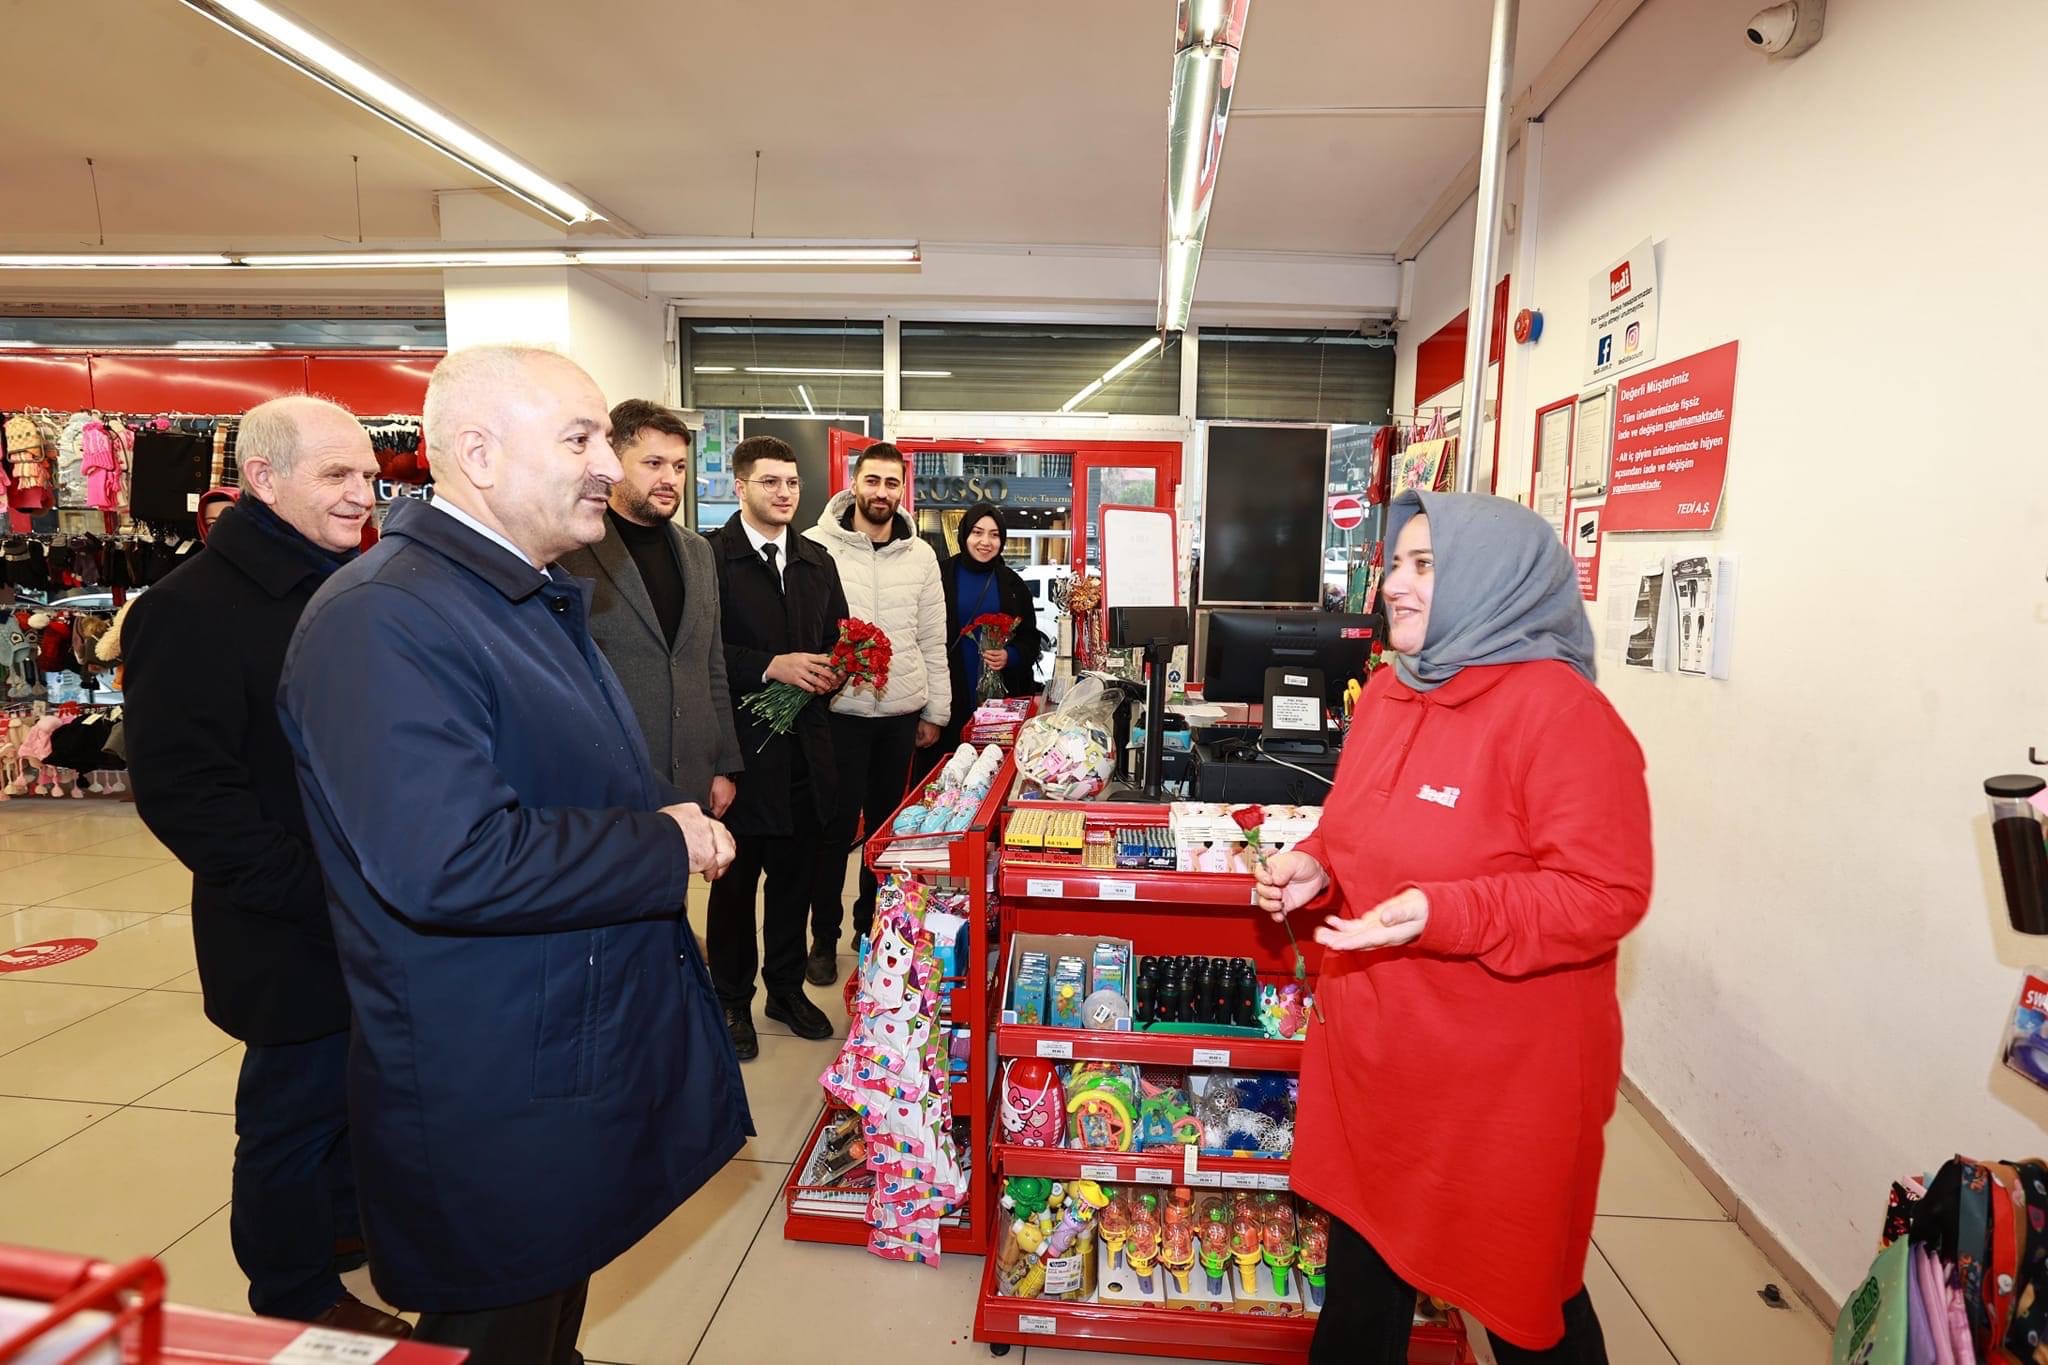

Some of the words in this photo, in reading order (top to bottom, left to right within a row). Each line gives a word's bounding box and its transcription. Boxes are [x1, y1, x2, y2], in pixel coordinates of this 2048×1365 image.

[1611, 267, 1630, 296] tedi
[1620, 383, 1646, 402] Değerli
[1646, 371, 1690, 394] Müşterimiz
[1618, 428, 1630, 440] iade
[1631, 427, 1639, 437] ve
[1639, 421, 1664, 438] değişim
[1664, 408, 1725, 432] yapılmamaktadır.
[1622, 412, 1636, 424] Tüm
[1636, 401, 1681, 421] ürünlerimizde
[1681, 395, 1700, 412] fişsiz
[1619, 452, 1628, 463] Alt
[1628, 450, 1635, 462] iç
[1635, 446, 1652, 463] giyim
[1652, 439, 1699, 458] ürünlerimizde
[1699, 434, 1724, 451] hijyen
[1615, 464, 1642, 479] açısından
[1643, 462, 1656, 476] iade
[1657, 462, 1666, 472] ve
[1666, 458, 1695, 474] değişim
[1677, 501, 1695, 514] TEDİ
